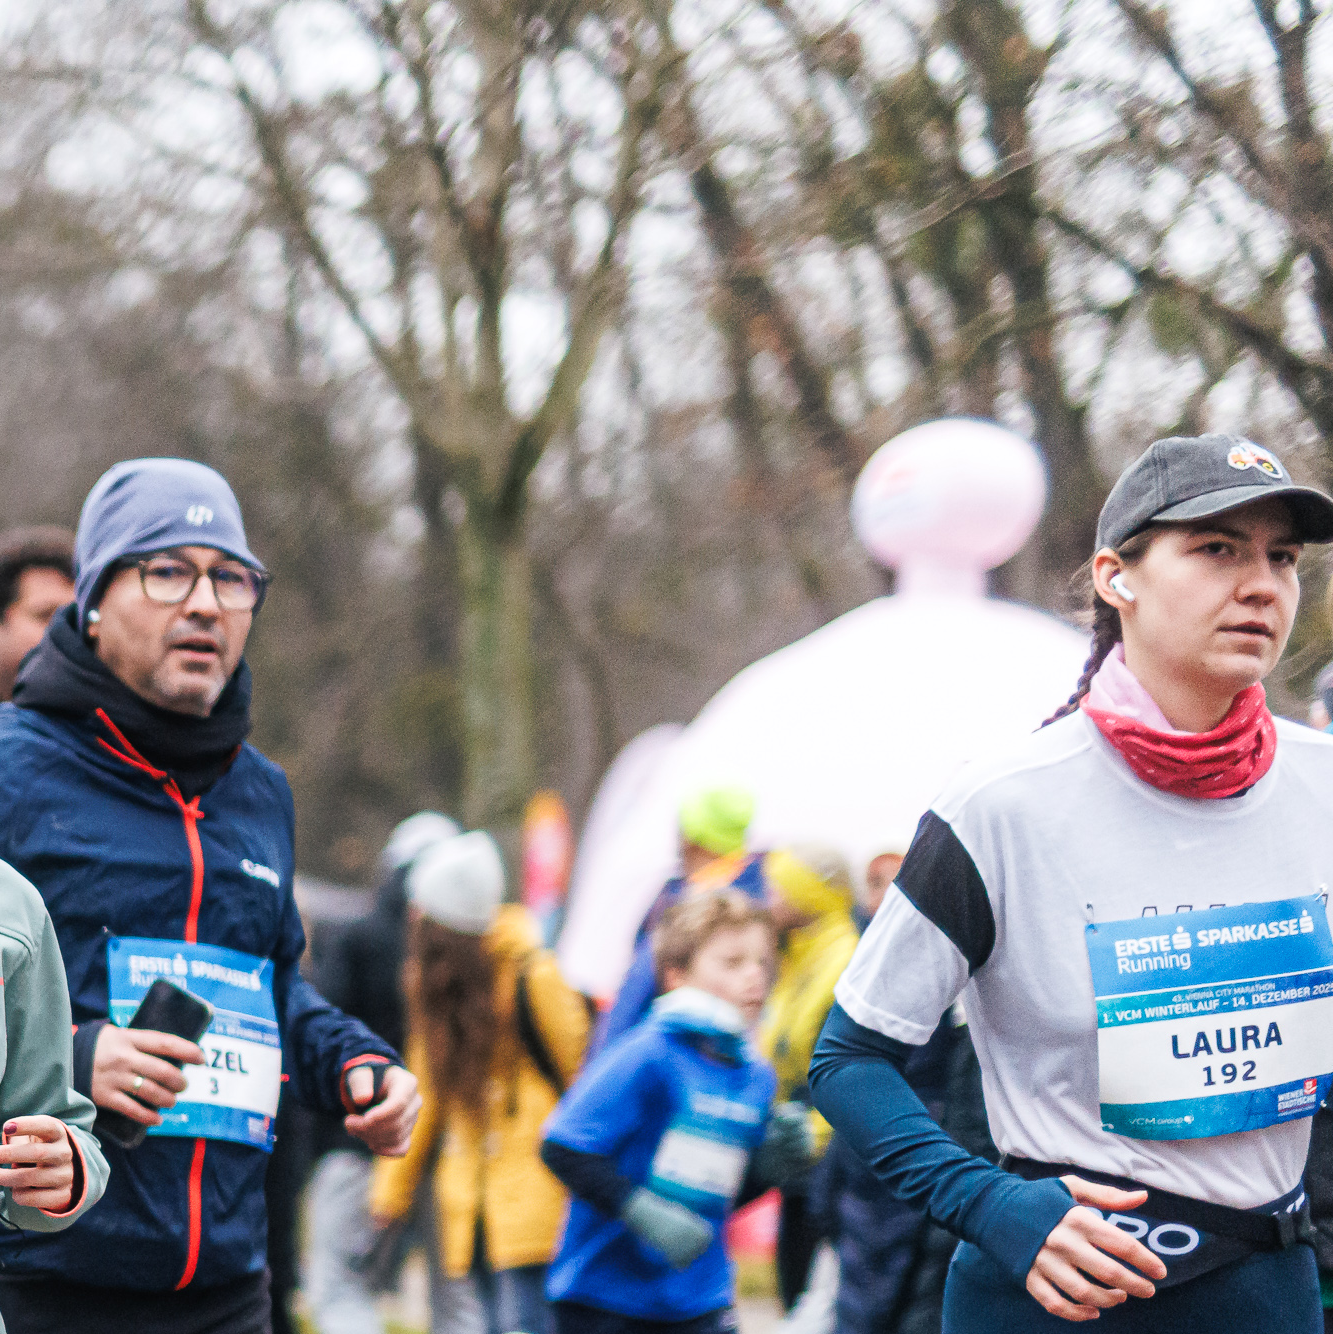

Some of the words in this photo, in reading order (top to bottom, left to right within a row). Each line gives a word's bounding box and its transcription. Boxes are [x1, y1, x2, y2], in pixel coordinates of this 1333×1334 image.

[1115, 935, 1170, 957] ERSTE
[1196, 918, 1299, 947] SPARKASSE
[130, 956, 172, 974] ERSTE
[1117, 952, 1191, 975] Running
[1215, 988, 1232, 998] CITY
[1233, 983, 1275, 995] MARATHON
[1102, 1013, 1113, 1023] 1.
[1116, 1009, 1142, 1022] VCM
[1144, 999, 1221, 1018] WINTERLAUF
[1233, 996, 1249, 1007] 14.
[1252, 986, 1310, 1004] DEZEMBER
[1171, 1021, 1283, 1059] LAURA
[1202, 1060, 1257, 1087] 192
